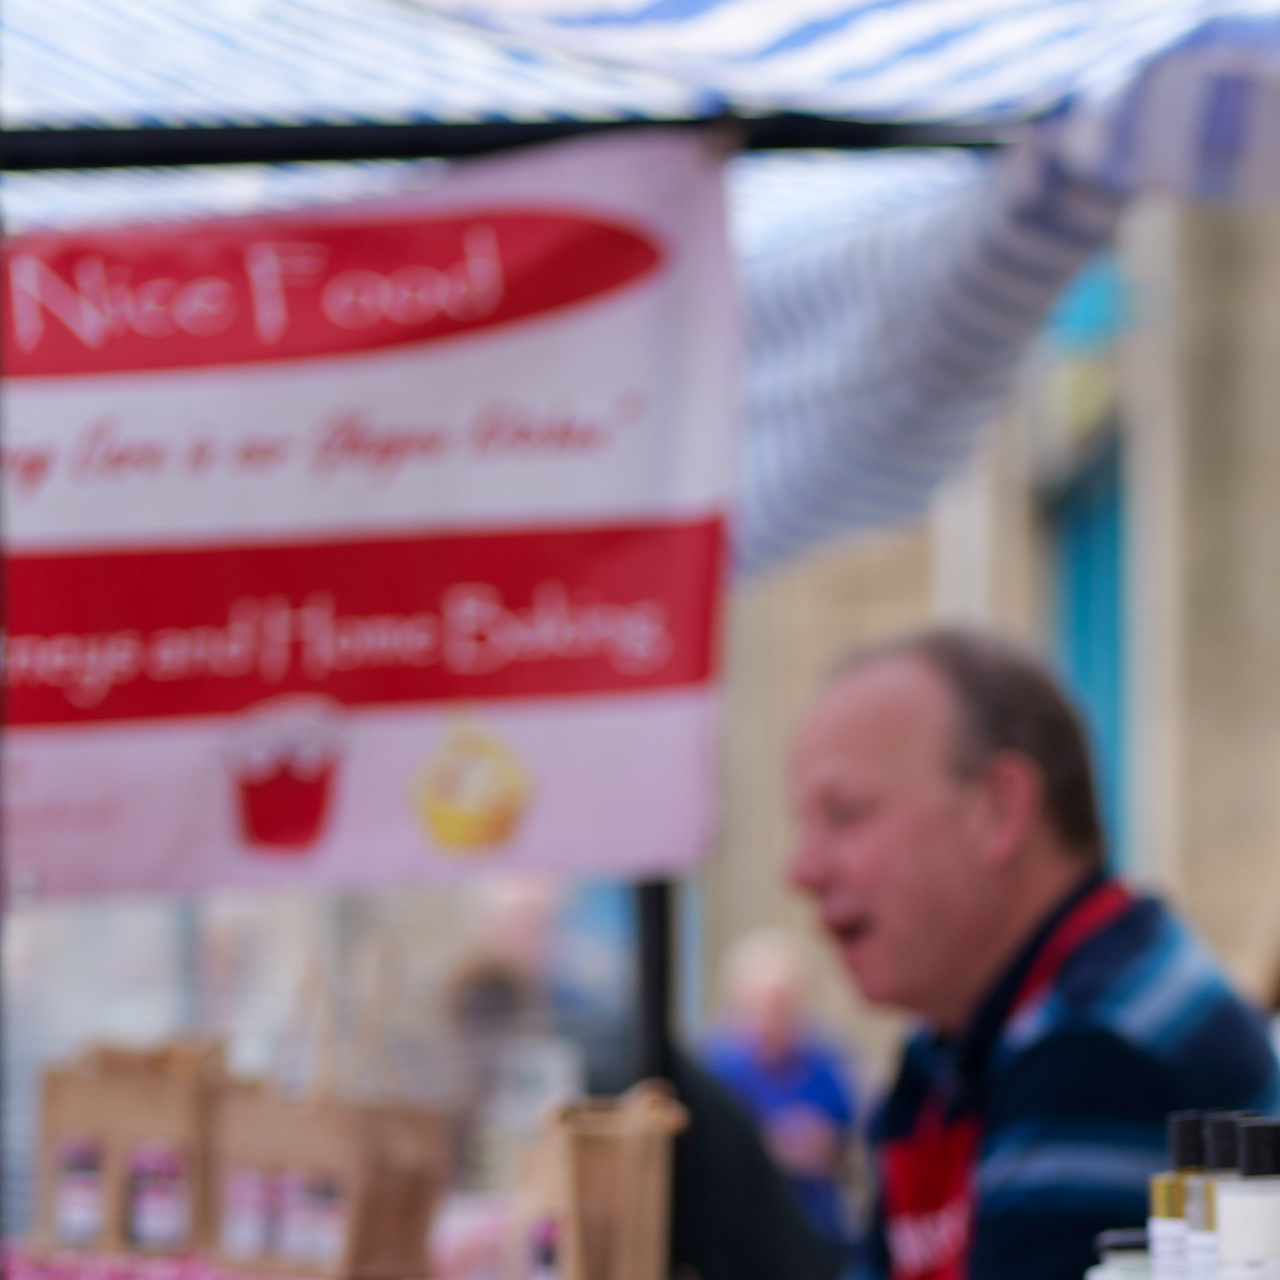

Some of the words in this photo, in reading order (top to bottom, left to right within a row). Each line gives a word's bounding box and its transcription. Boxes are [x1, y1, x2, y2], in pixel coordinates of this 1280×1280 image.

[8, 248, 236, 353] Nice
[245, 222, 503, 344] Food
[143, 592, 257, 681] and
[258, 588, 441, 682] Home
[441, 574, 673, 678] Baking
